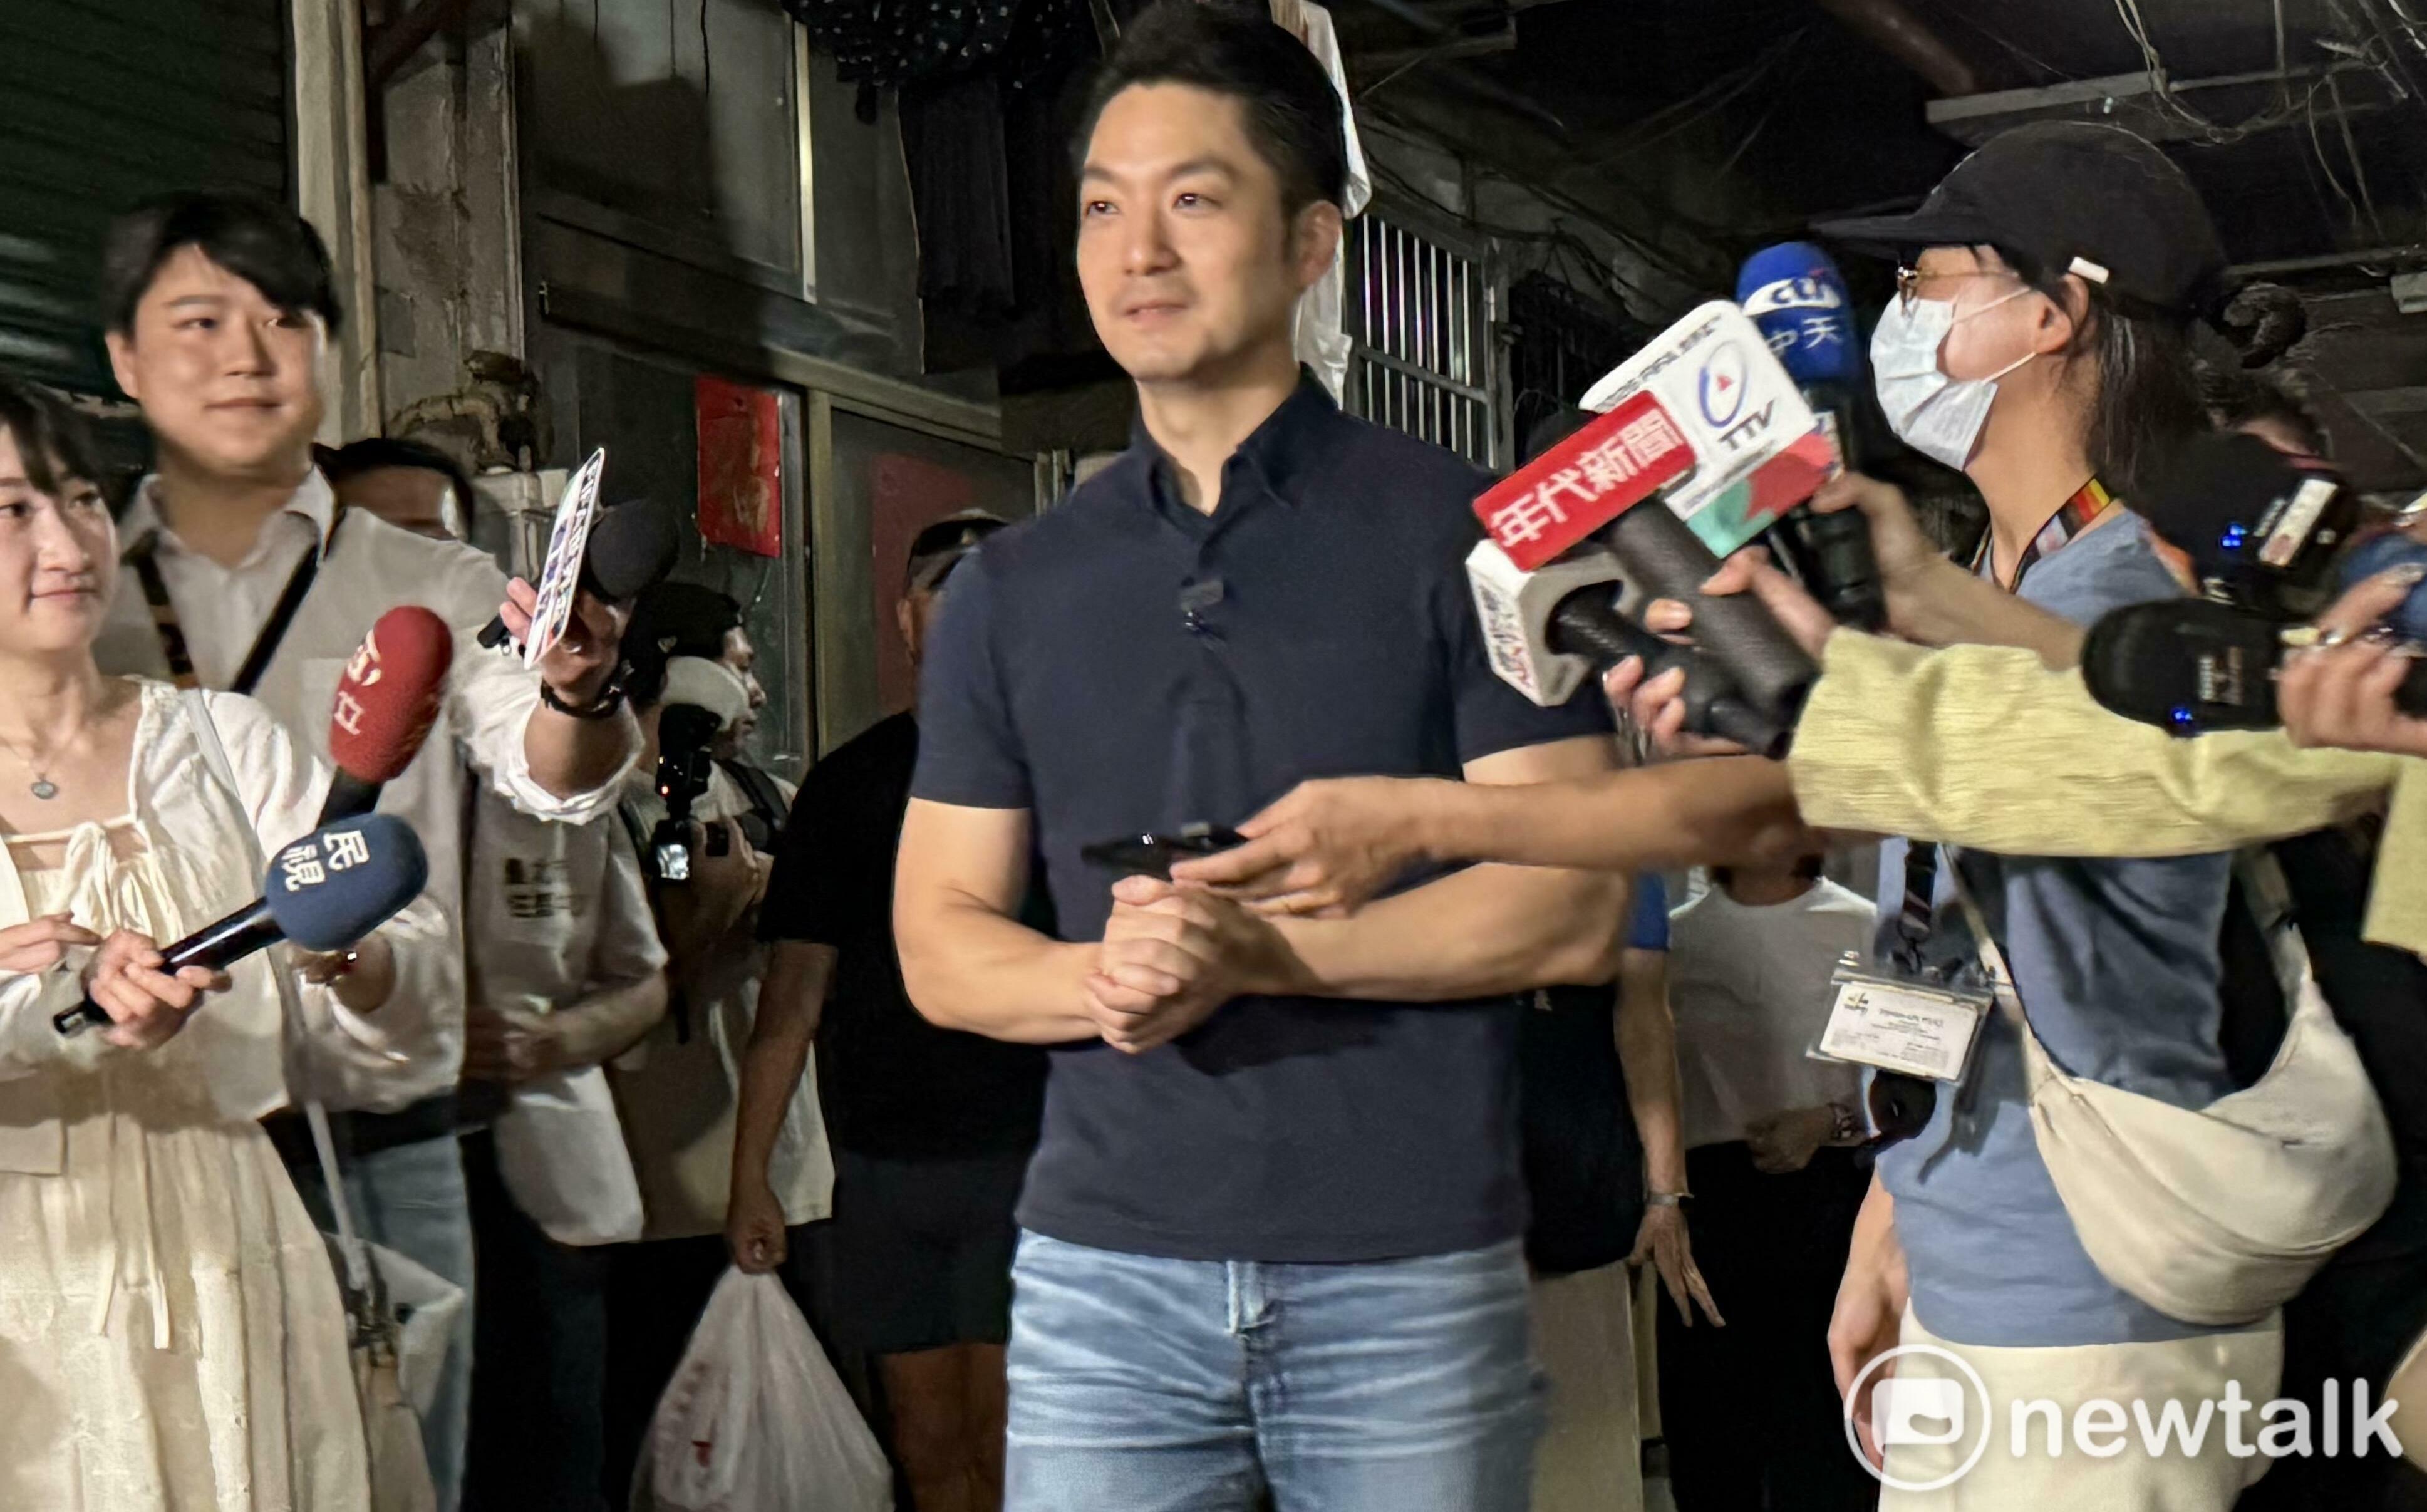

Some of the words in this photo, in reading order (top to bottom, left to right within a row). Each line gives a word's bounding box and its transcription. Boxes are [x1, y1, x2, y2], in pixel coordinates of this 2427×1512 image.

[1767, 316, 1844, 356] 中天
[1718, 399, 1774, 450] TTV
[1490, 408, 1685, 547] 年代新聞
[281, 829, 370, 892] 民視
